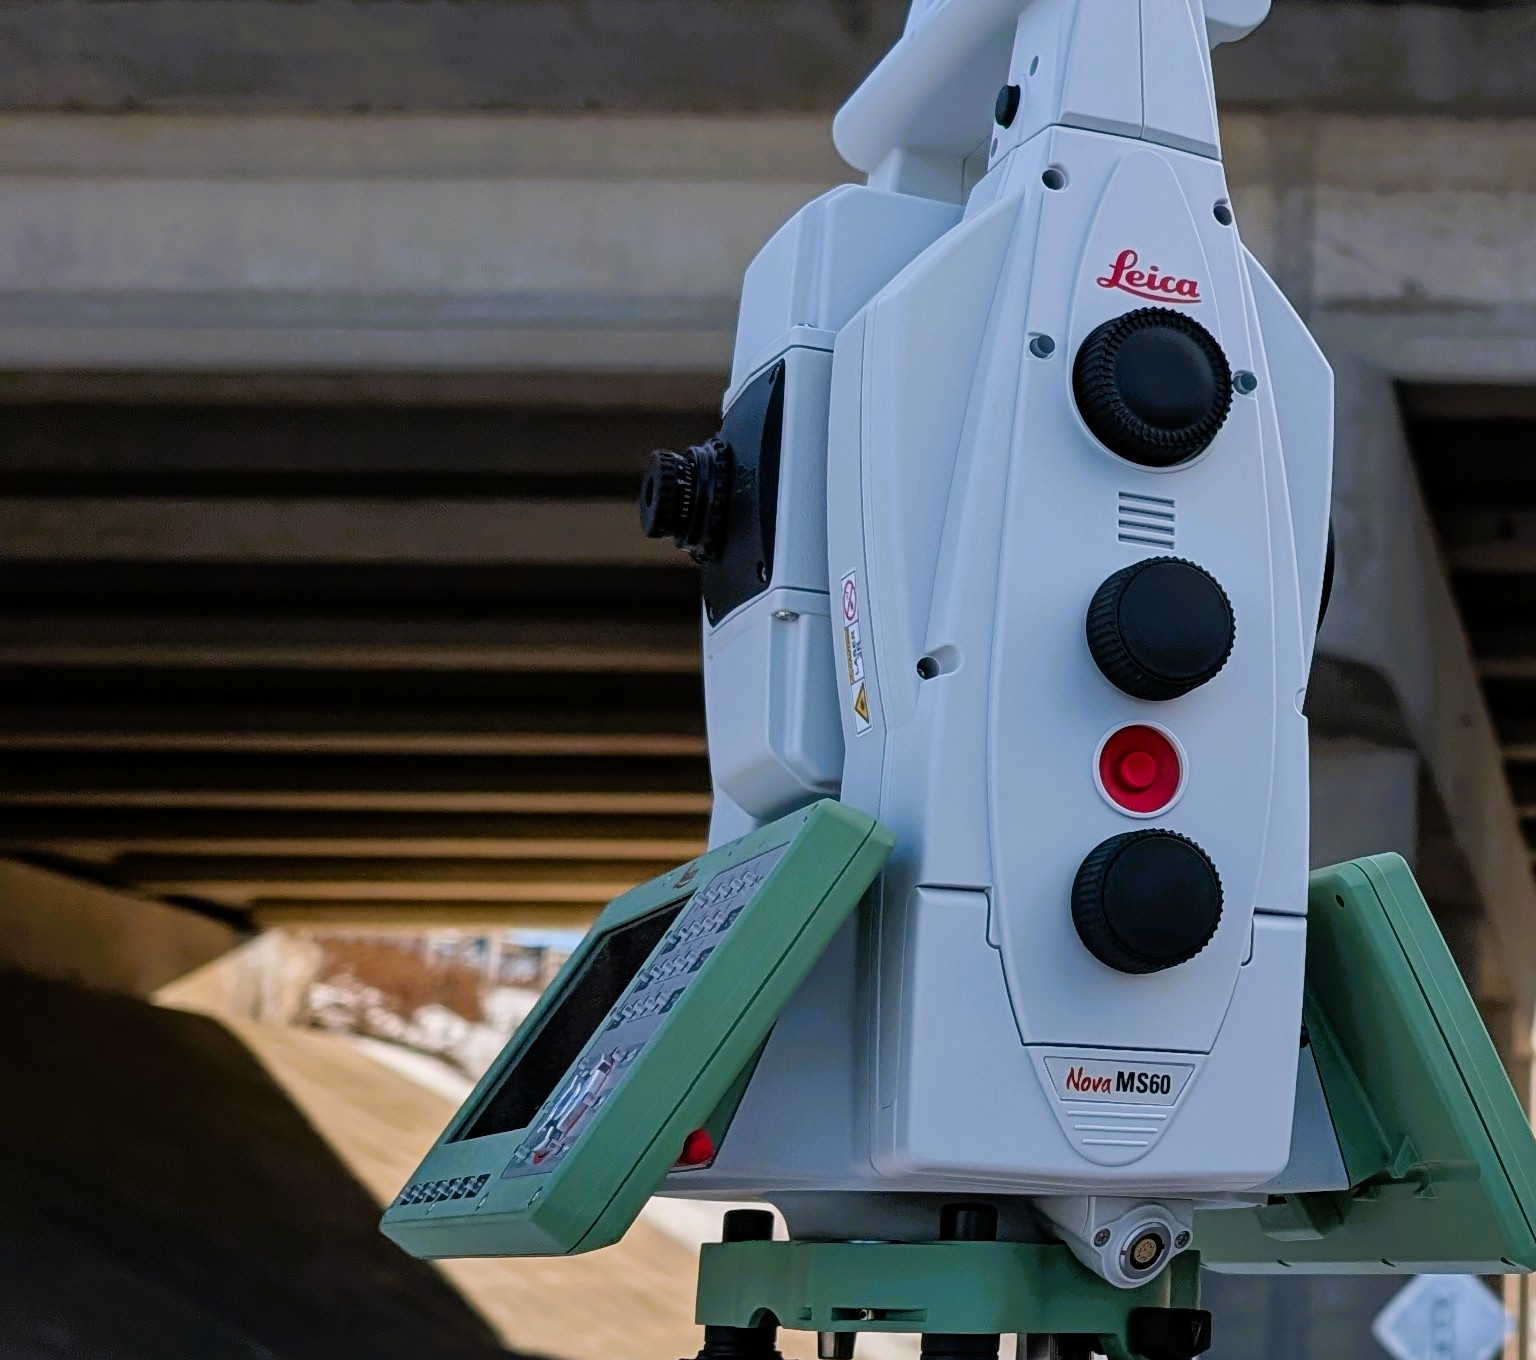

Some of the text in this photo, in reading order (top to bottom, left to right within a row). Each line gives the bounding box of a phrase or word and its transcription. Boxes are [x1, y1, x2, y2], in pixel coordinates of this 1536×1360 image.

[1097, 249, 1202, 303] Leica
[1066, 1066, 1171, 1095] Nova MS60
